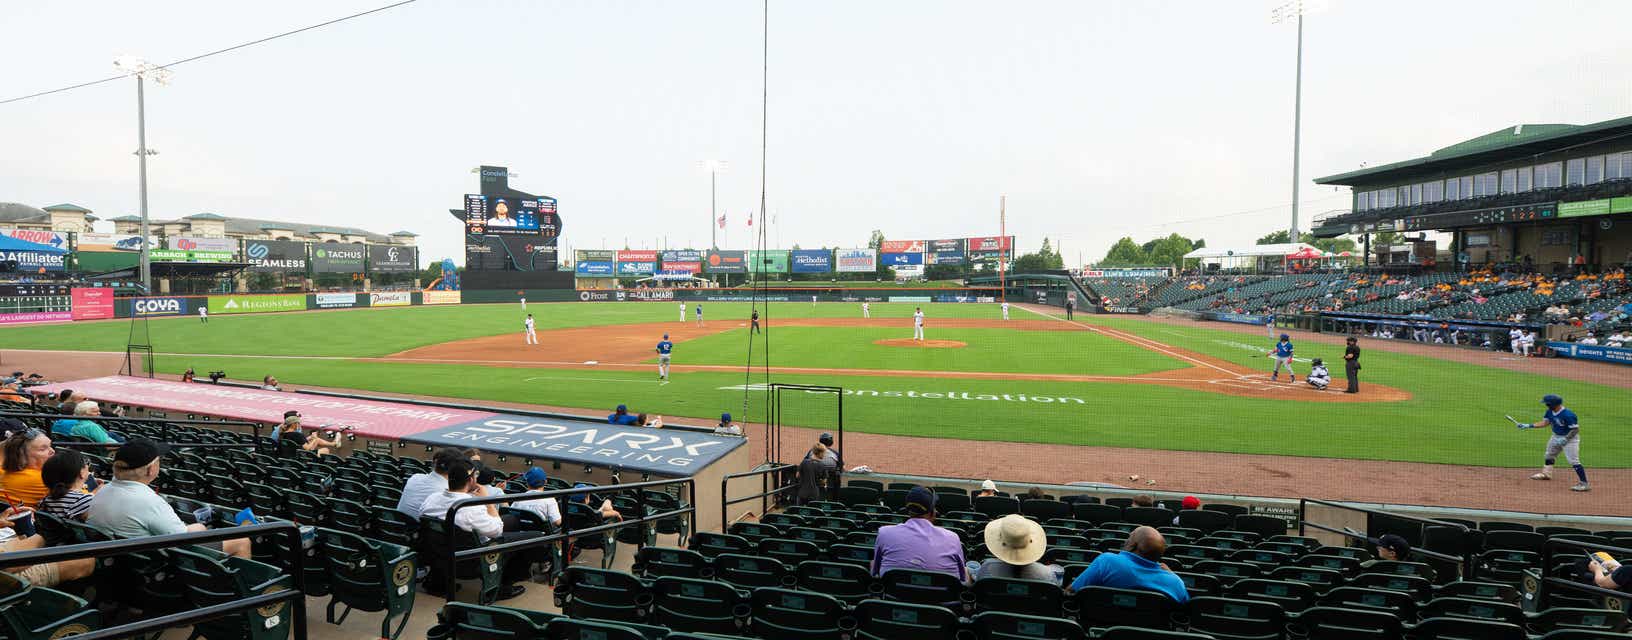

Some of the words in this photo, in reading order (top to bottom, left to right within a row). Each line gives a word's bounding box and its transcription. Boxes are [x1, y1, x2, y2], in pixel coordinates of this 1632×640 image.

[10, 231, 53, 243] ARROW
[328, 251, 361, 259] TACHUS
[248, 259, 305, 268] SEAMLESS
[591, 292, 608, 300] Frost
[135, 300, 180, 313] GOYA
[466, 420, 722, 456] SPARX
[441, 431, 694, 467] ENGINEERING
